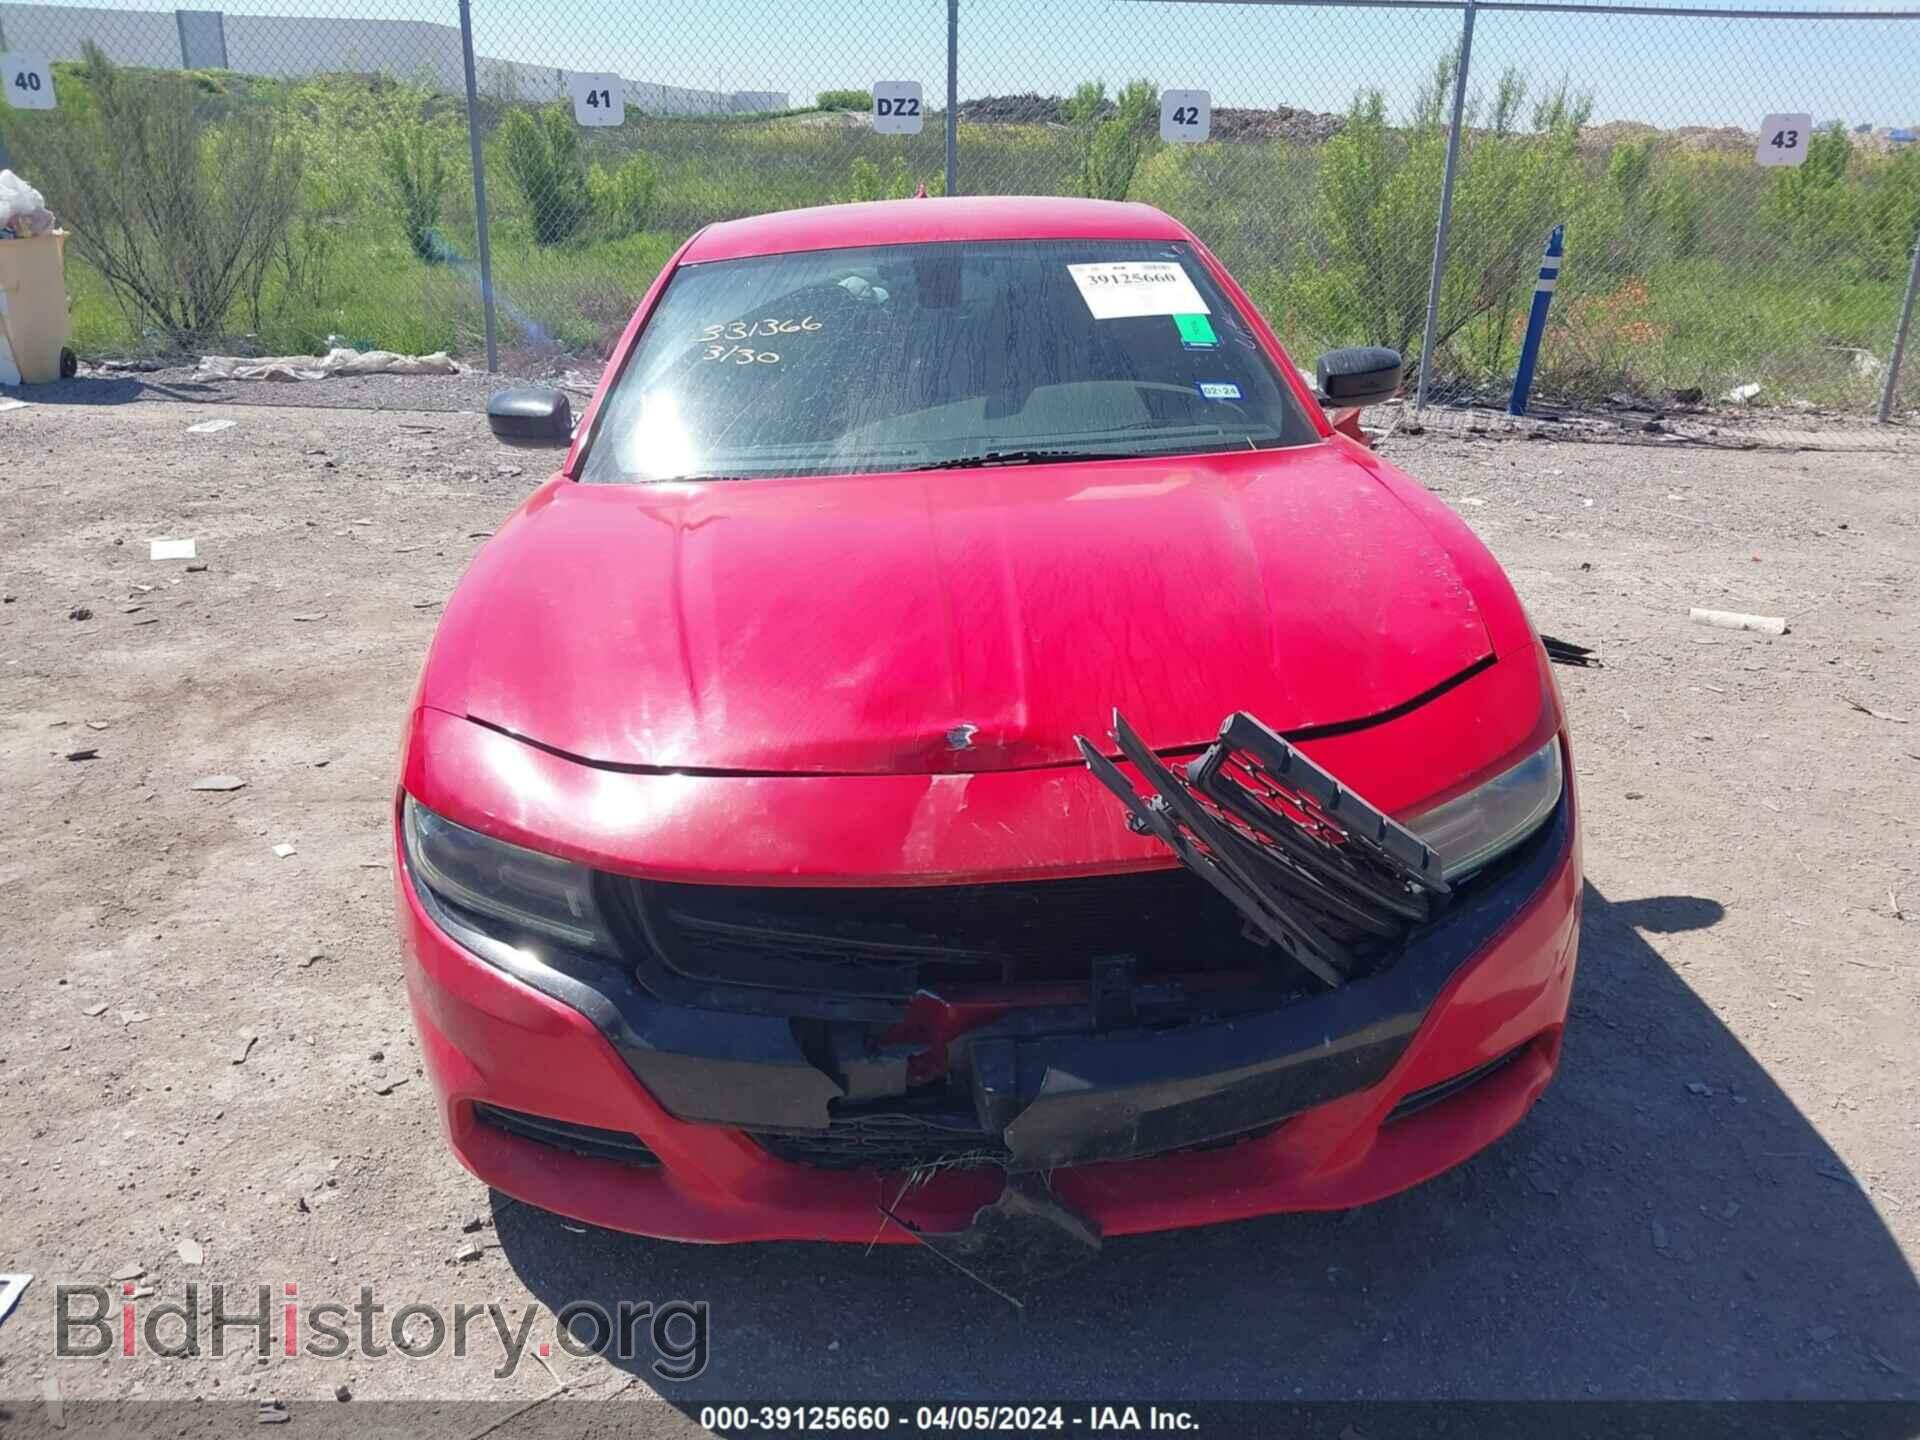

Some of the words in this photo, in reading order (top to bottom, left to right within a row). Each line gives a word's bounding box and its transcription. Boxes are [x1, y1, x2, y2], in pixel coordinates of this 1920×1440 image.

[15, 72, 41, 91] 40
[586, 90, 610, 108] 41
[877, 98, 920, 116] DZ2
[1172, 107, 1199, 125] 42
[1770, 130, 1799, 149] 43
[1087, 272, 1176, 286] 39125660
[695, 315, 823, 342] 331366
[703, 344, 780, 365] 3/30
